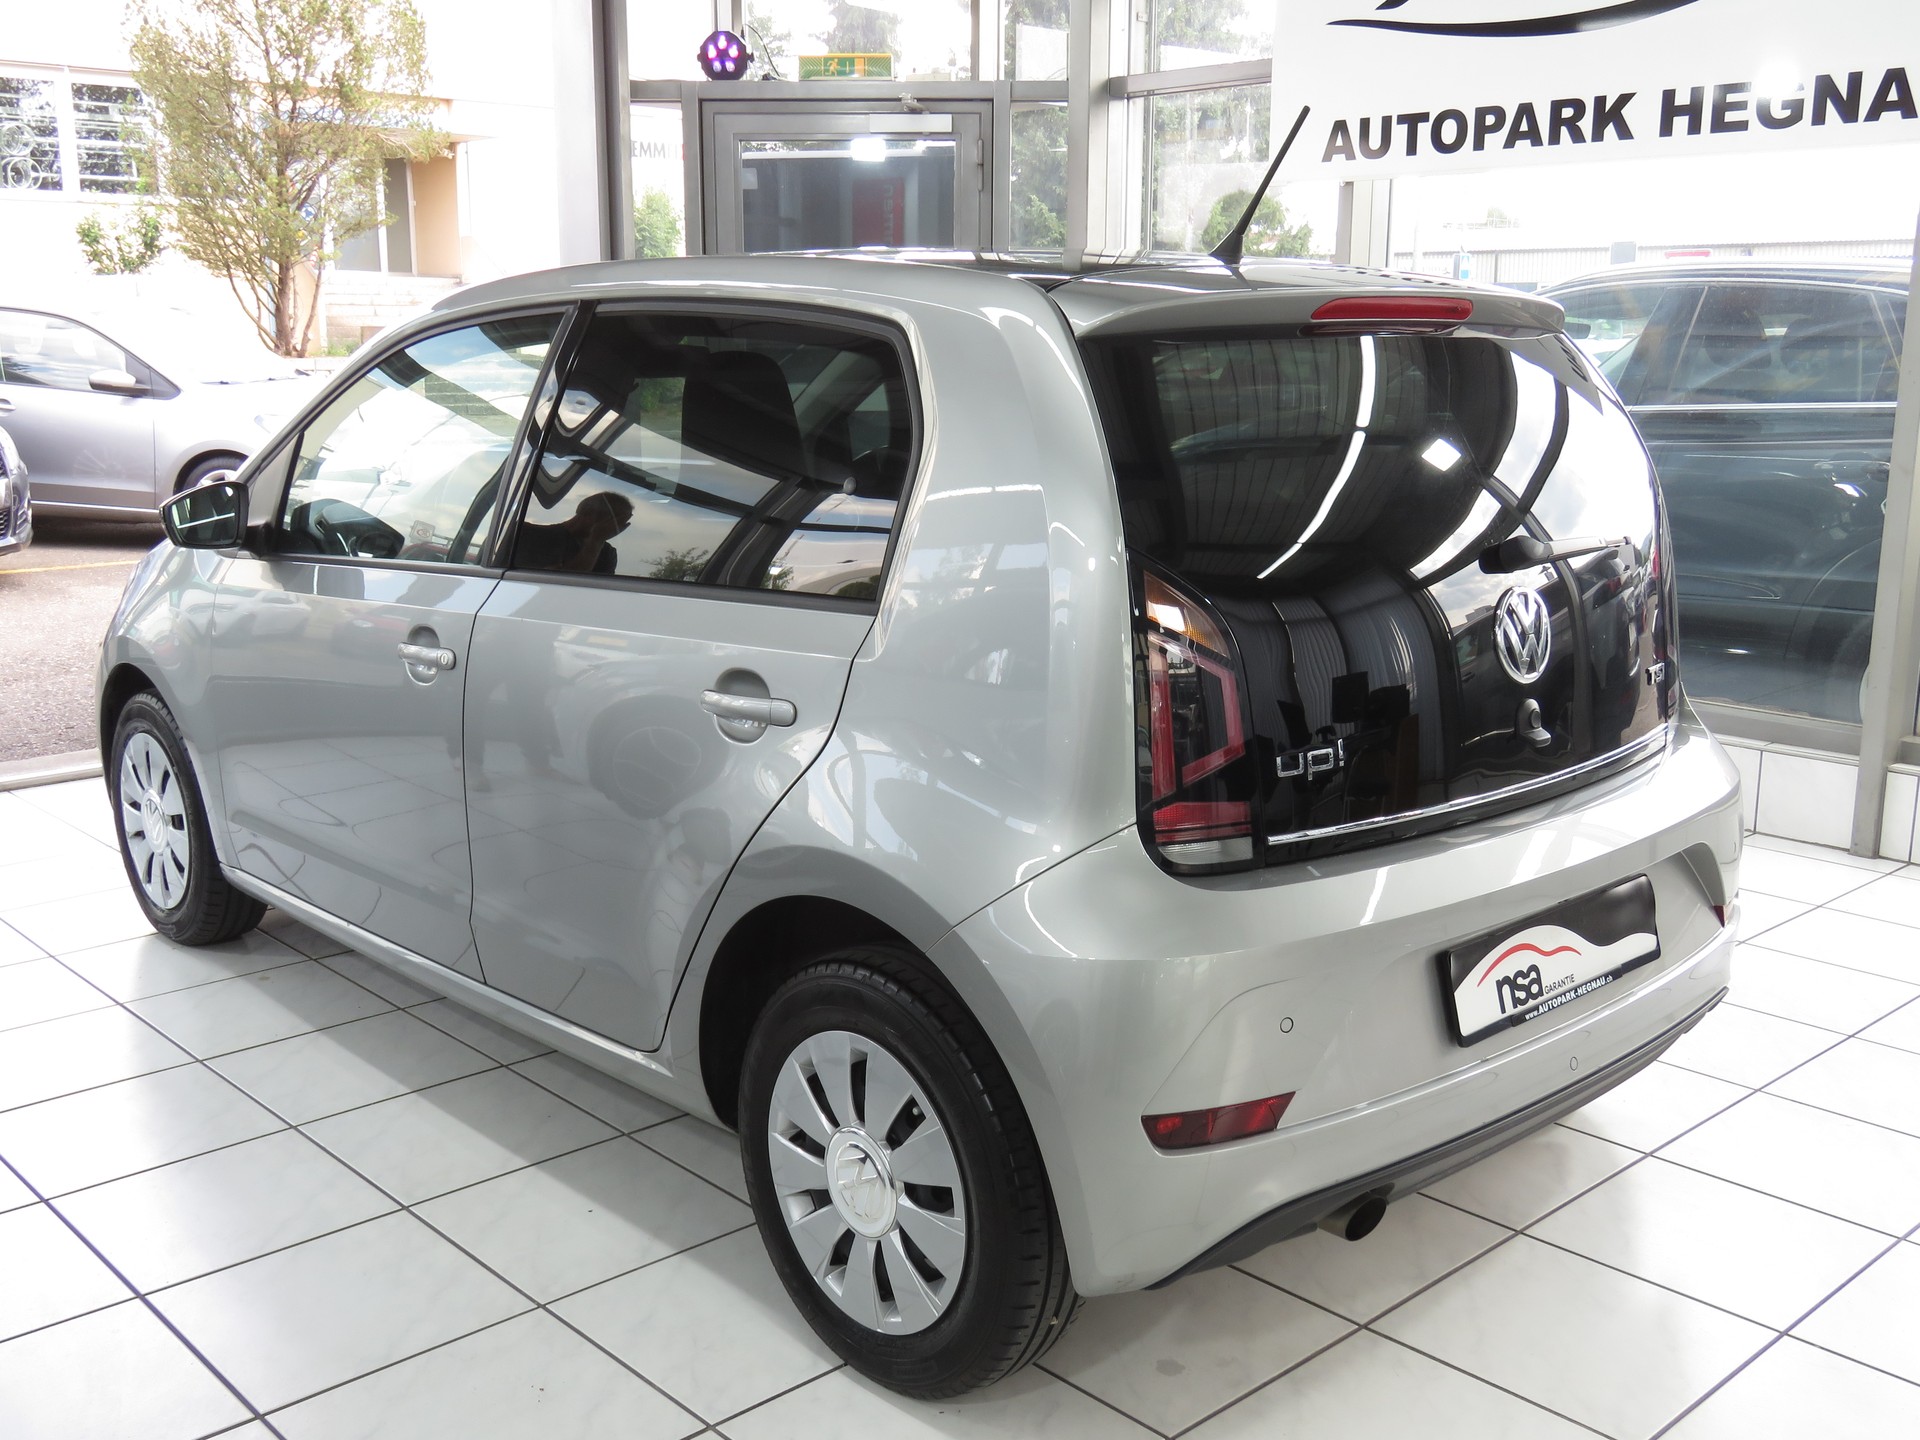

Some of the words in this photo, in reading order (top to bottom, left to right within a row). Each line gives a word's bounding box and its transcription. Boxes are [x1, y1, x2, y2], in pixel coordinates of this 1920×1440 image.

[1321, 92, 1635, 163] AUTOPARK
[1276, 738, 1345, 780] up!
[1496, 963, 1544, 1014] nsa
[1524, 975, 1614, 1021] www.AUTOPARK-HEGNAU.ch
[1544, 973, 1576, 995] GARANTIE
